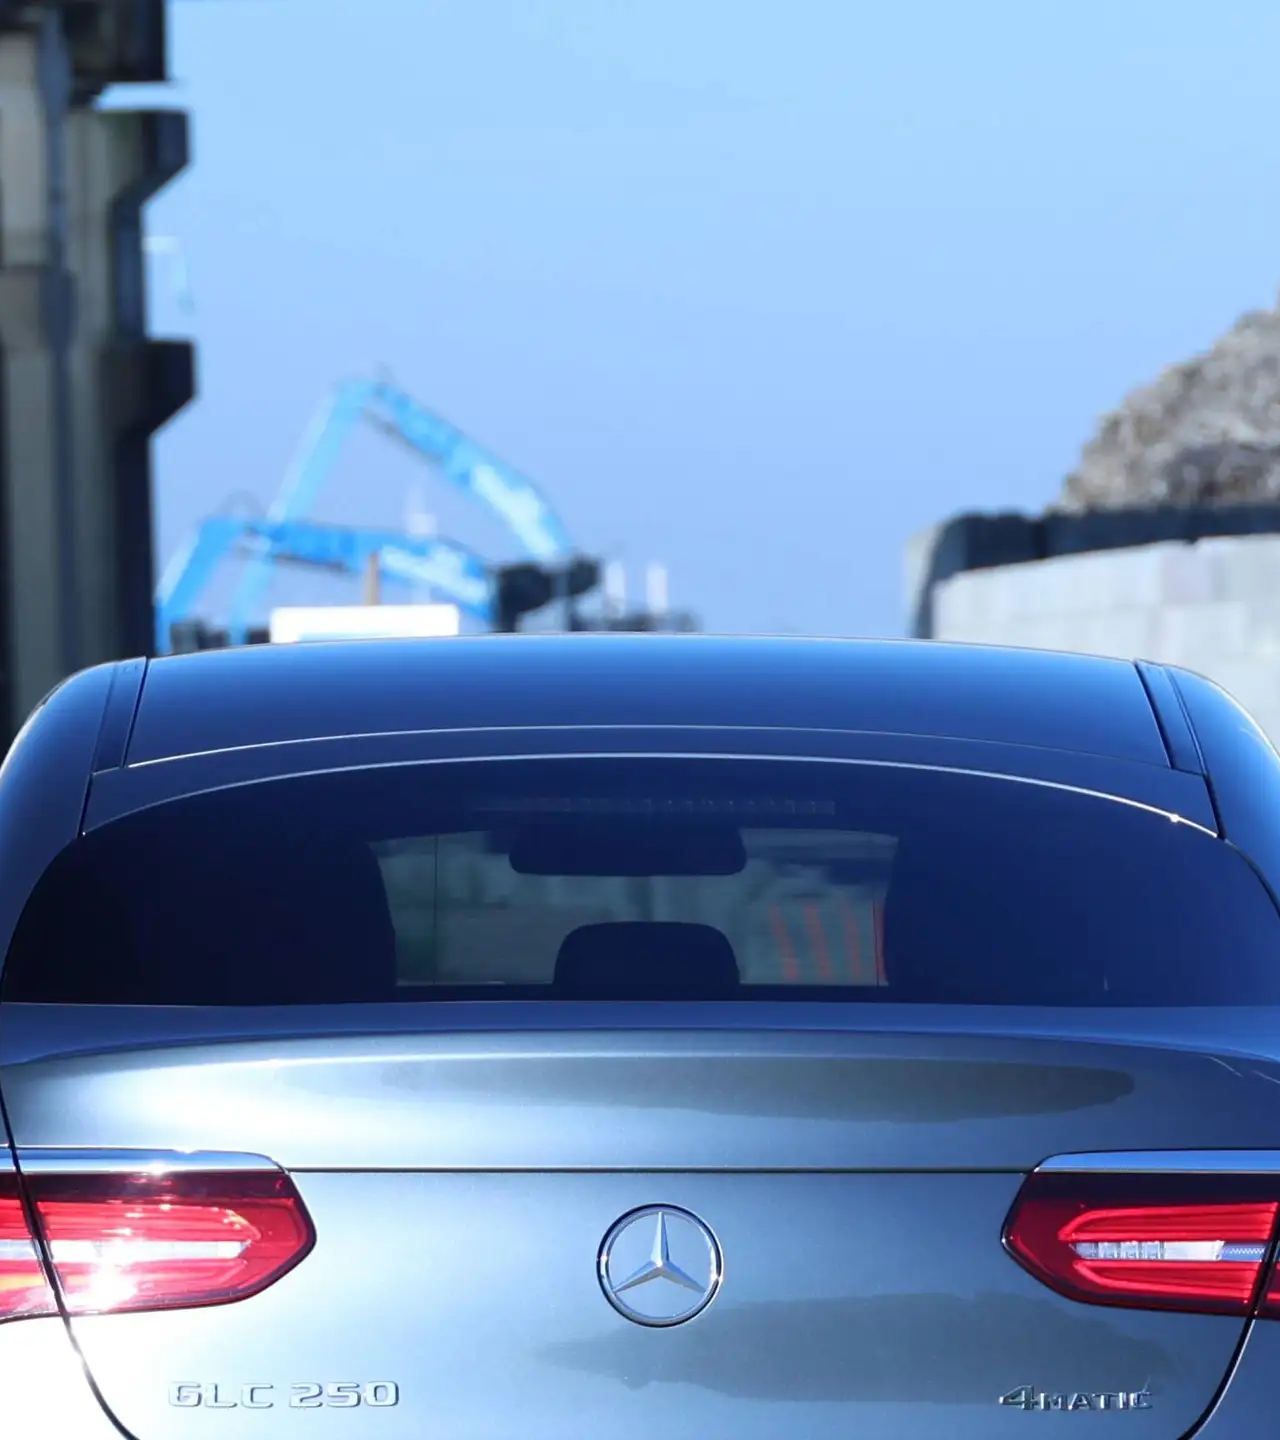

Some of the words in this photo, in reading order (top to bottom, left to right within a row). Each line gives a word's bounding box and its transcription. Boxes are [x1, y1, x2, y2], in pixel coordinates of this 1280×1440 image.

[169, 1381, 274, 1409] GLC
[288, 1380, 400, 1408] 250
[999, 1384, 1154, 1411] 4MATIC
